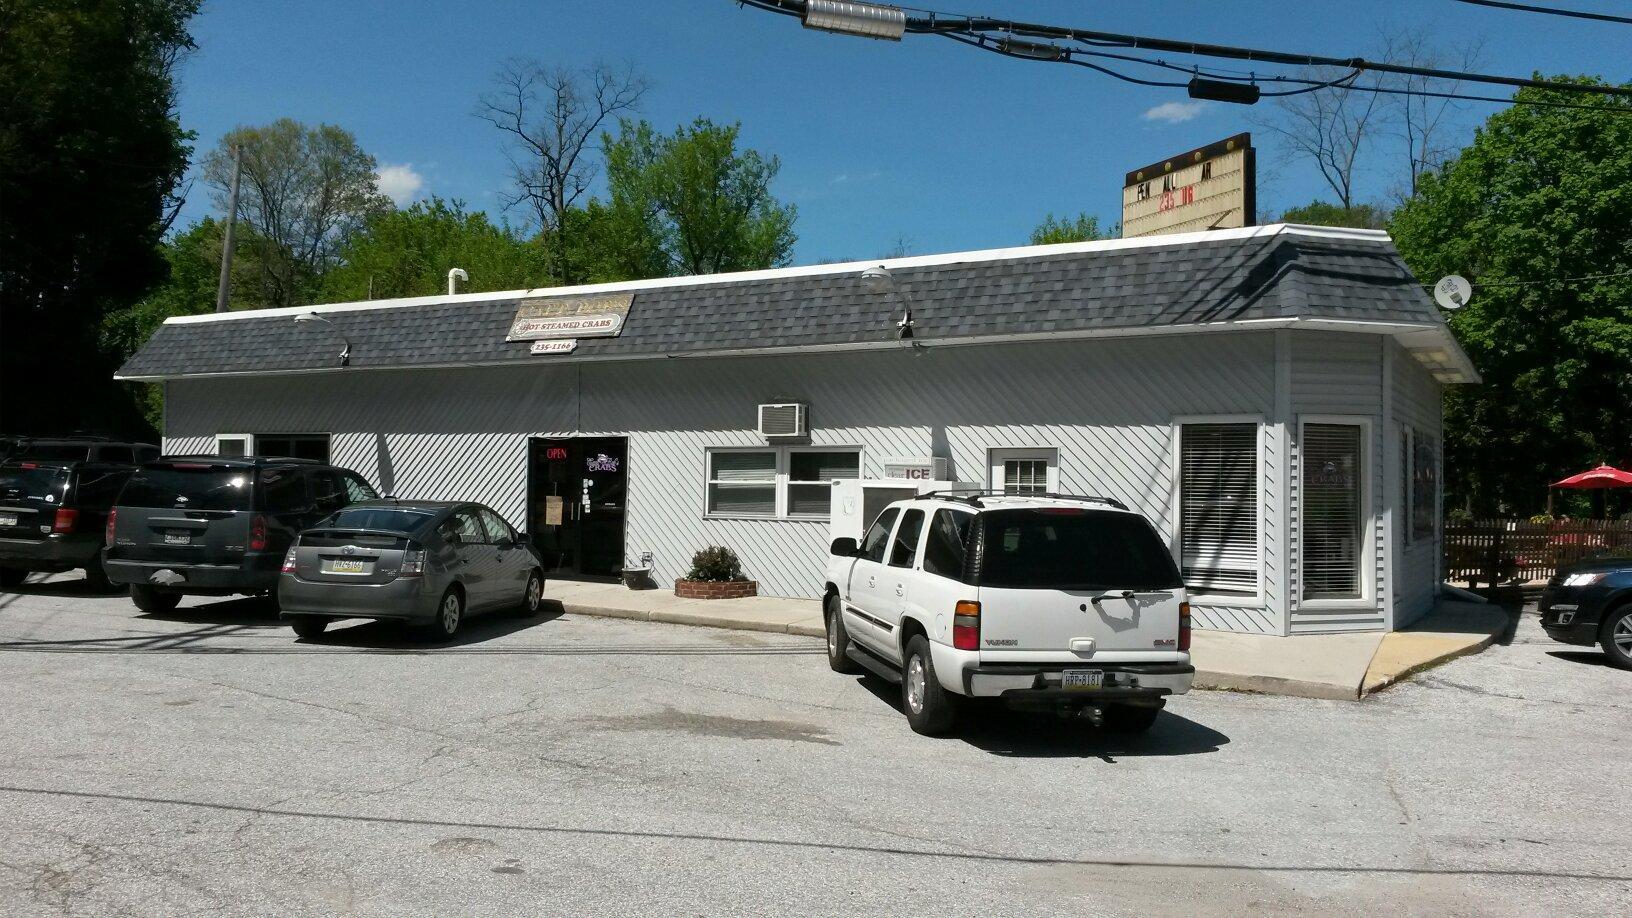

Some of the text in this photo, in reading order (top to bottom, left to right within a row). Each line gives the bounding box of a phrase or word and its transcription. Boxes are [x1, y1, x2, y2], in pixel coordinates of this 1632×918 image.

[522, 319, 612, 331] HOT STEAMED CRABS
[534, 343, 571, 351] 235-1166
[546, 448, 567, 459] OPEN
[589, 463, 617, 472] CRABS
[905, 468, 930, 479] ICE
